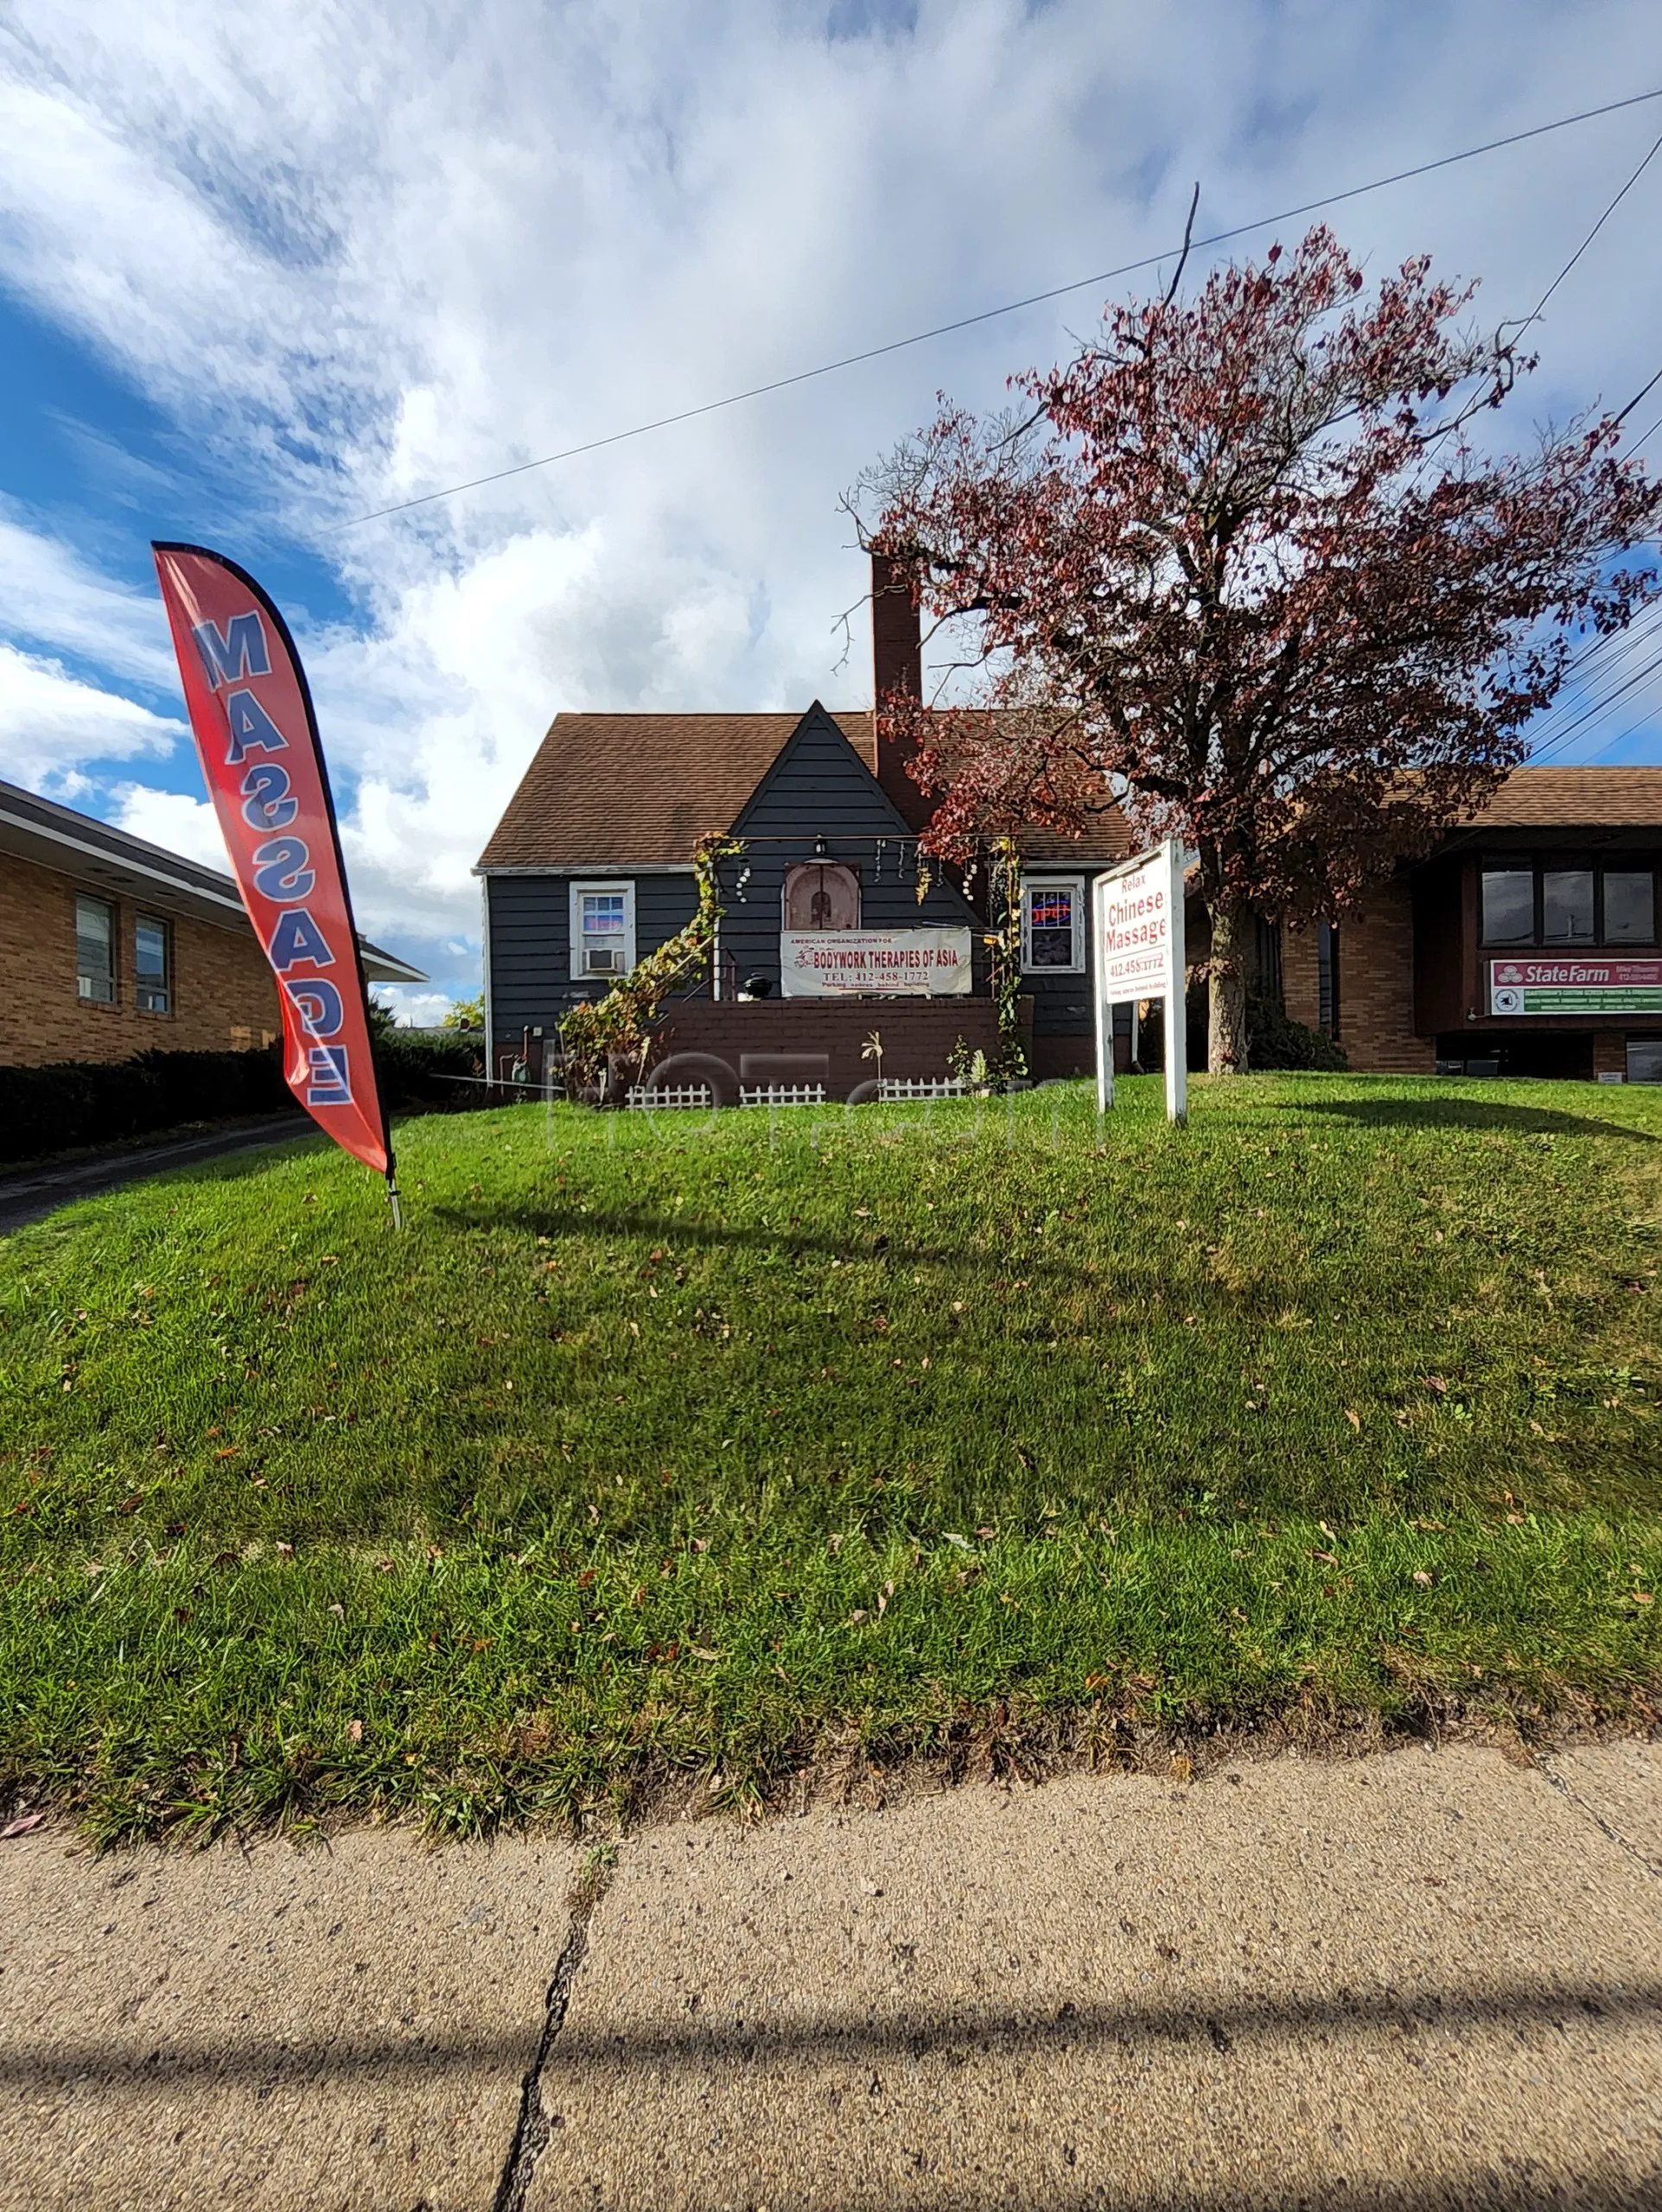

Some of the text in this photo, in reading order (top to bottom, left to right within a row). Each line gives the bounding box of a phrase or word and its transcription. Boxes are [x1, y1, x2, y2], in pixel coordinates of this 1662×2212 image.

[1121, 874, 1146, 893] Relax
[1108, 891, 1163, 927] Chinese
[1105, 918, 1166, 954] Massage
[813, 949, 958, 969] BODYWORK THERAPIES OF ASIA
[823, 971, 929, 982] TEL: 412-458-1772
